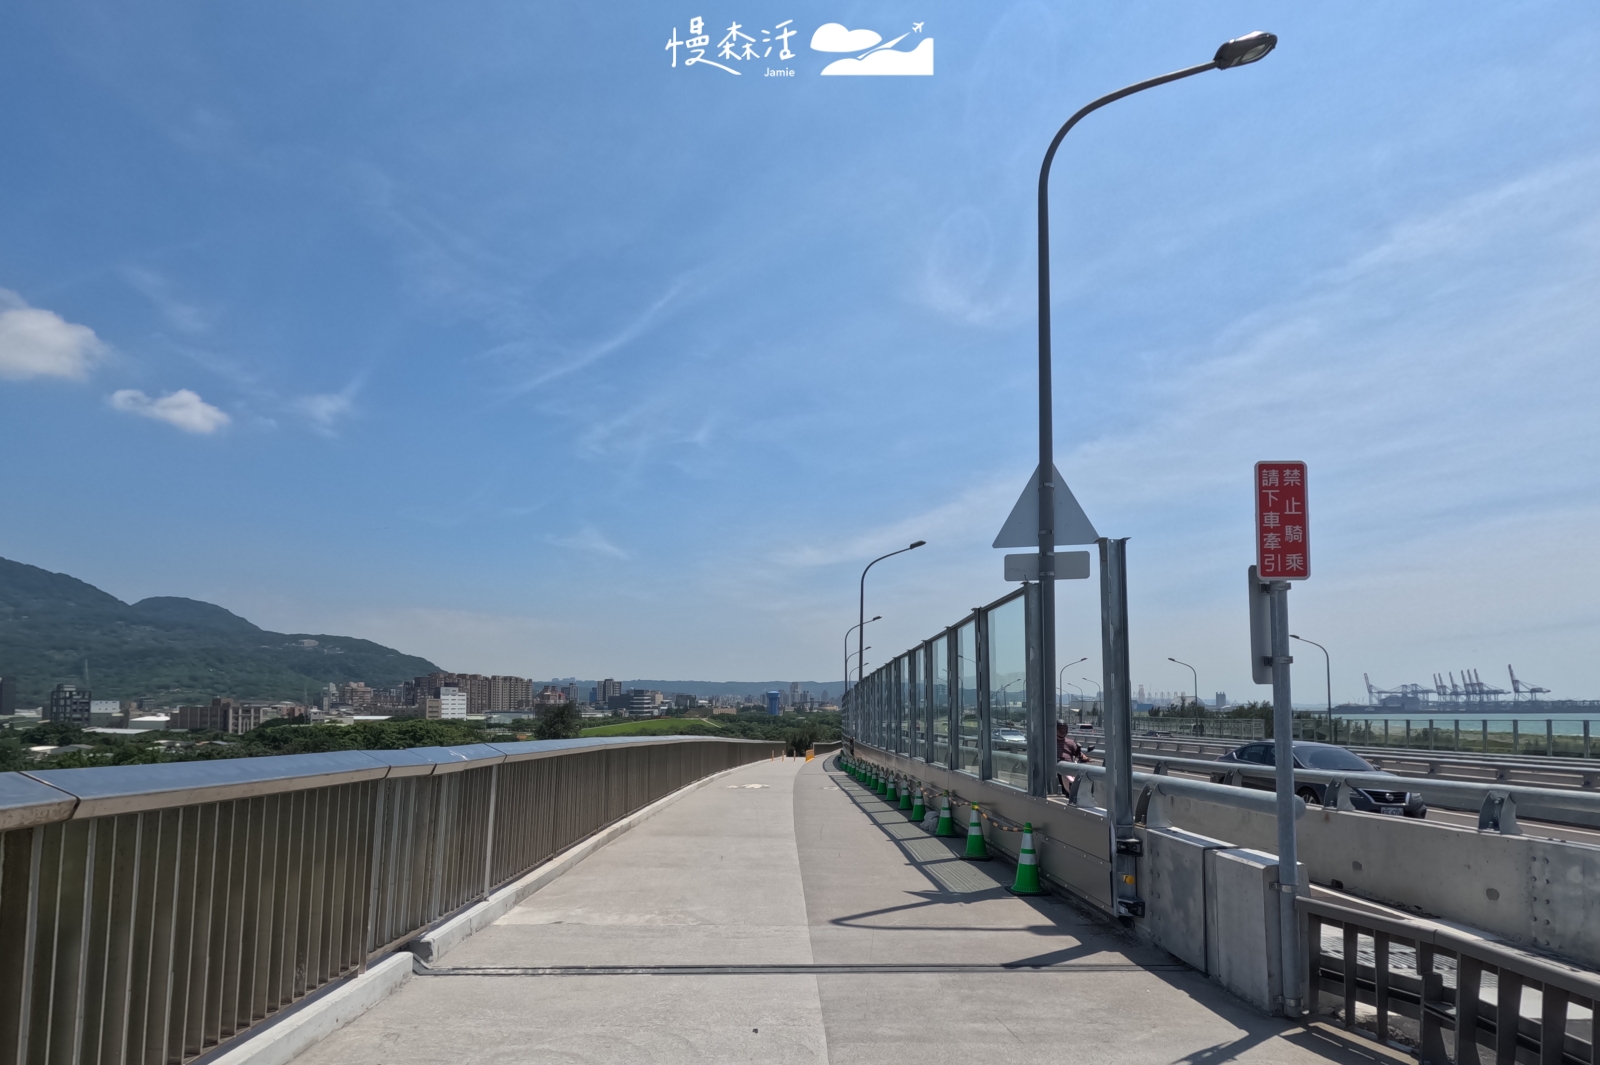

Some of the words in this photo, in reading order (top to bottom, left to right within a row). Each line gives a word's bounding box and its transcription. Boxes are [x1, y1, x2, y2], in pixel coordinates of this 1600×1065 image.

[1261, 469, 1282, 572] 請下車牽引
[1283, 469, 1304, 571] 禁止騎乘
